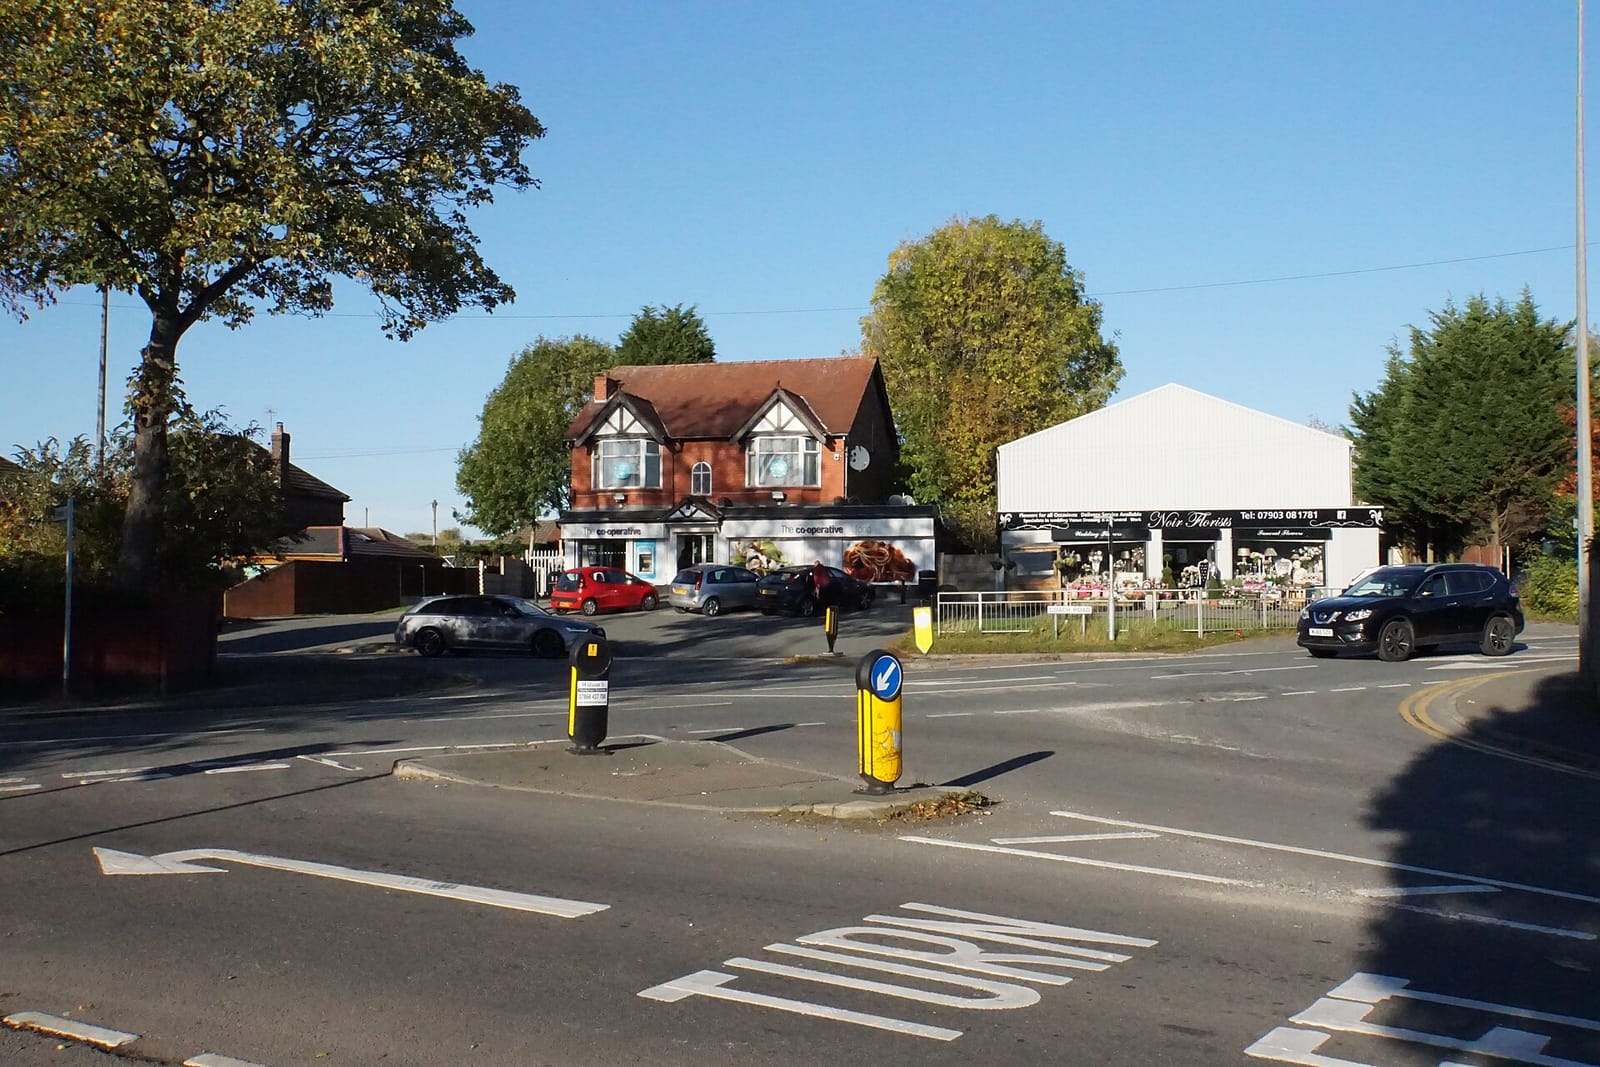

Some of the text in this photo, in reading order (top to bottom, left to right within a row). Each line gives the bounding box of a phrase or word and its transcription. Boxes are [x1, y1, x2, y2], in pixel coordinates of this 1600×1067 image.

[1147, 511, 1232, 528] Noir Florists
[1240, 512, 1256, 520] Tel:
[1257, 512, 1284, 520] 07903
[597, 527, 641, 536] co-operative
[796, 525, 843, 535] co-operative
[637, 902, 1159, 1042] TURN
